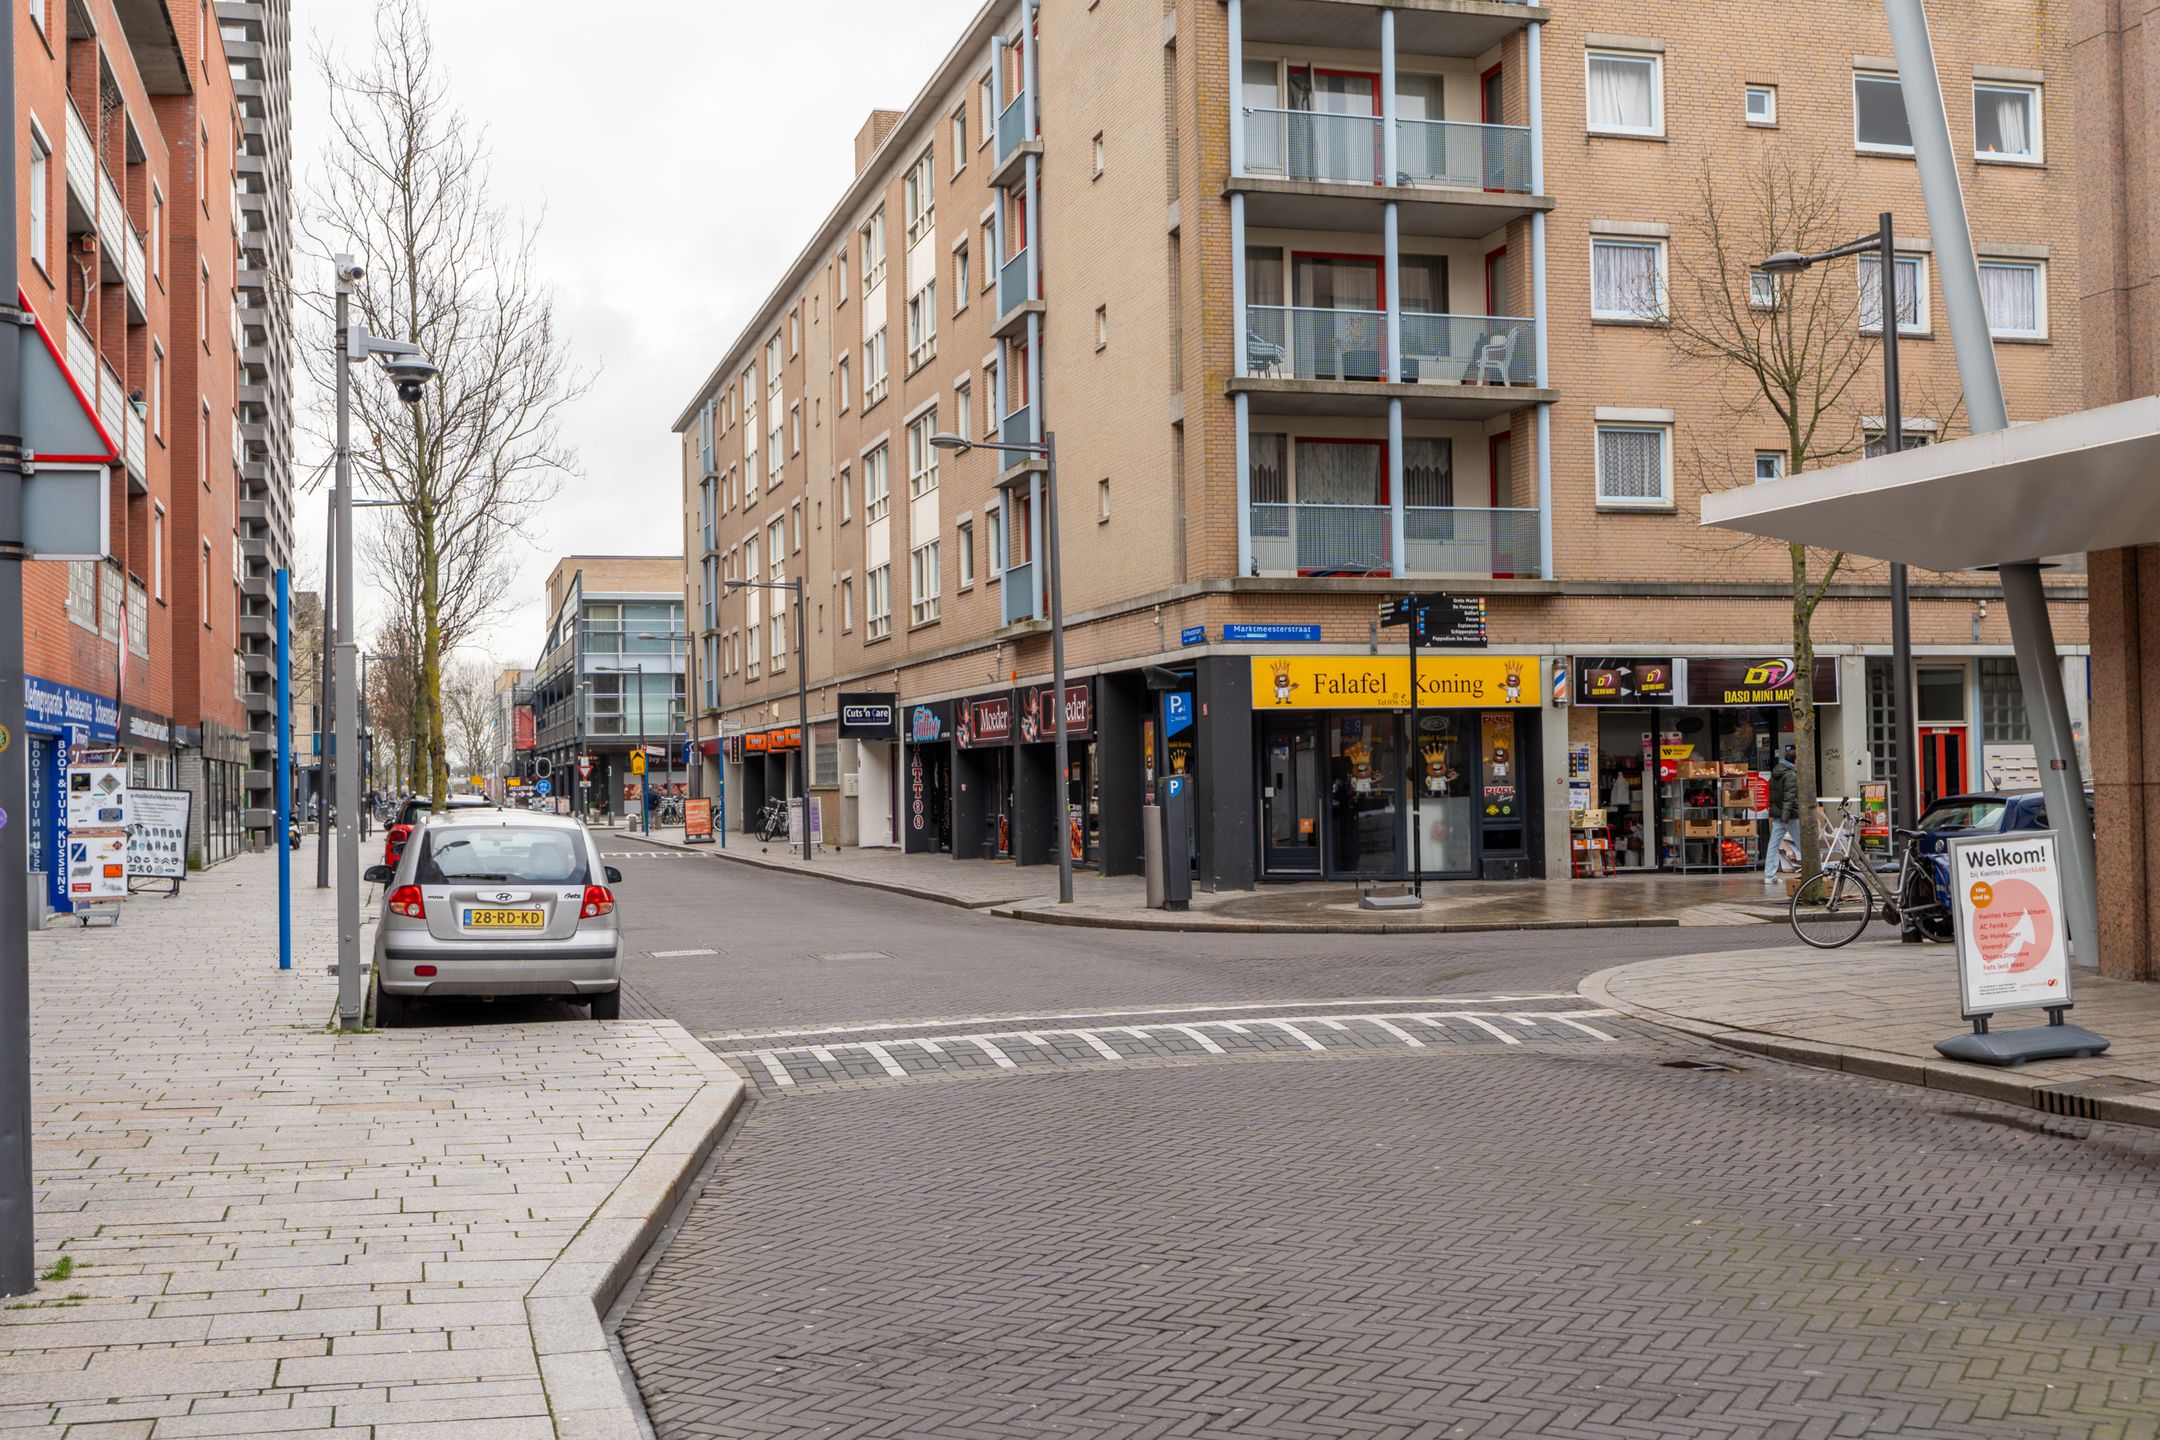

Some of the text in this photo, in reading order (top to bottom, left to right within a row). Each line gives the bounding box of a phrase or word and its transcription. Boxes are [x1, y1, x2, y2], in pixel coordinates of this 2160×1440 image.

[1233, 625, 1311, 633] Marktmeesterstraat
[1313, 672, 1387, 694] Falafel
[1170, 696, 1182, 714] P
[1724, 690, 1750, 703] DASO
[1752, 690, 1773, 702] MINI
[846, 709, 863, 717] Cuts
[871, 709, 889, 717] Care
[981, 705, 1008, 731] Moeder
[58, 741, 66, 776] BOOT
[1170, 780, 1178, 793] P
[58, 791, 66, 827] TUIN
[58, 831, 66, 894] KUSSENS
[1966, 845, 2046, 868] Welkom!
[1970, 871, 1978, 879] bij
[474, 911, 540, 925] 28-RD-KD
